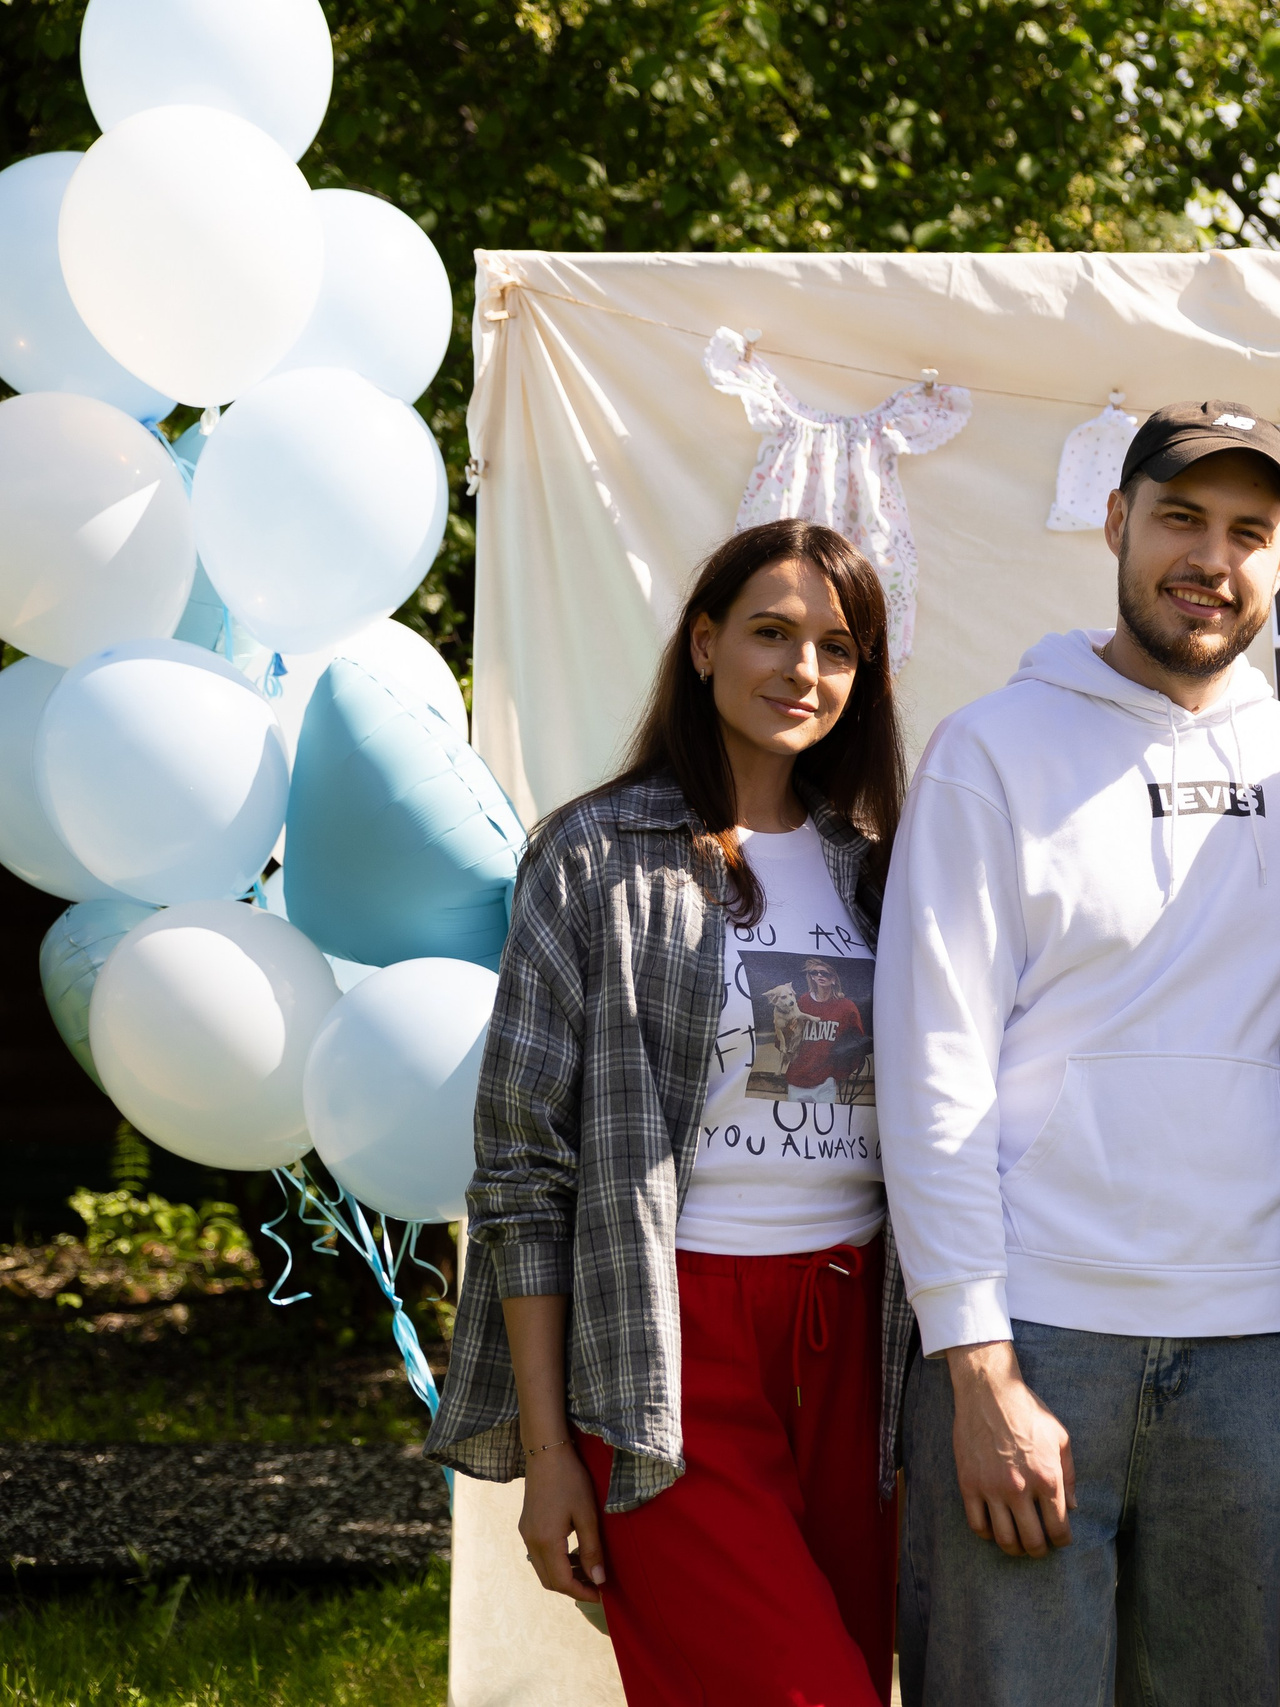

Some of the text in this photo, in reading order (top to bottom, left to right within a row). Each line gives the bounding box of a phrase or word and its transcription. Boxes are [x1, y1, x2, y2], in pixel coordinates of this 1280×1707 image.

[726, 916, 777, 947] OU
[704, 1125, 766, 1156] YOU
[781, 1132, 869, 1160] ALWAYS
